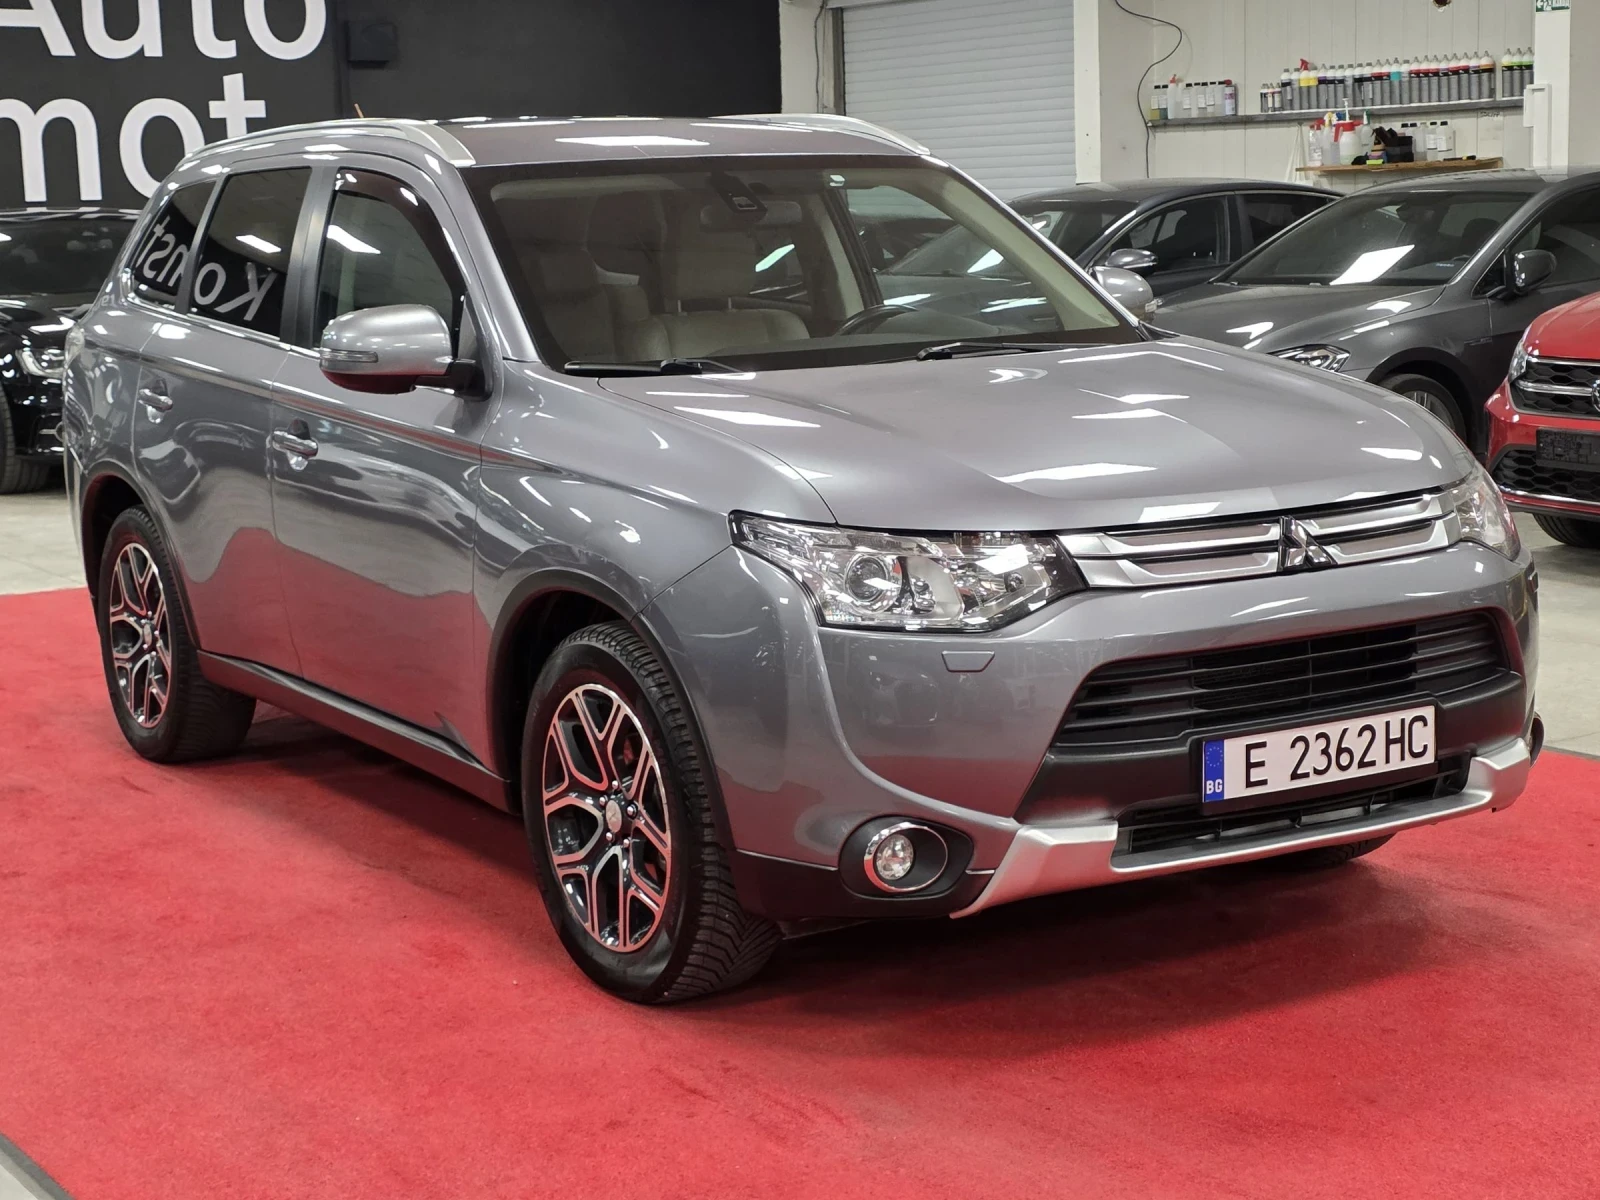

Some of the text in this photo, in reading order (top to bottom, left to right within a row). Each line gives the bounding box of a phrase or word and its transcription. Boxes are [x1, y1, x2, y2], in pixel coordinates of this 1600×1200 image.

[1245, 714, 1429, 789] E 2362 HC
[1205, 778, 1223, 795] BG
